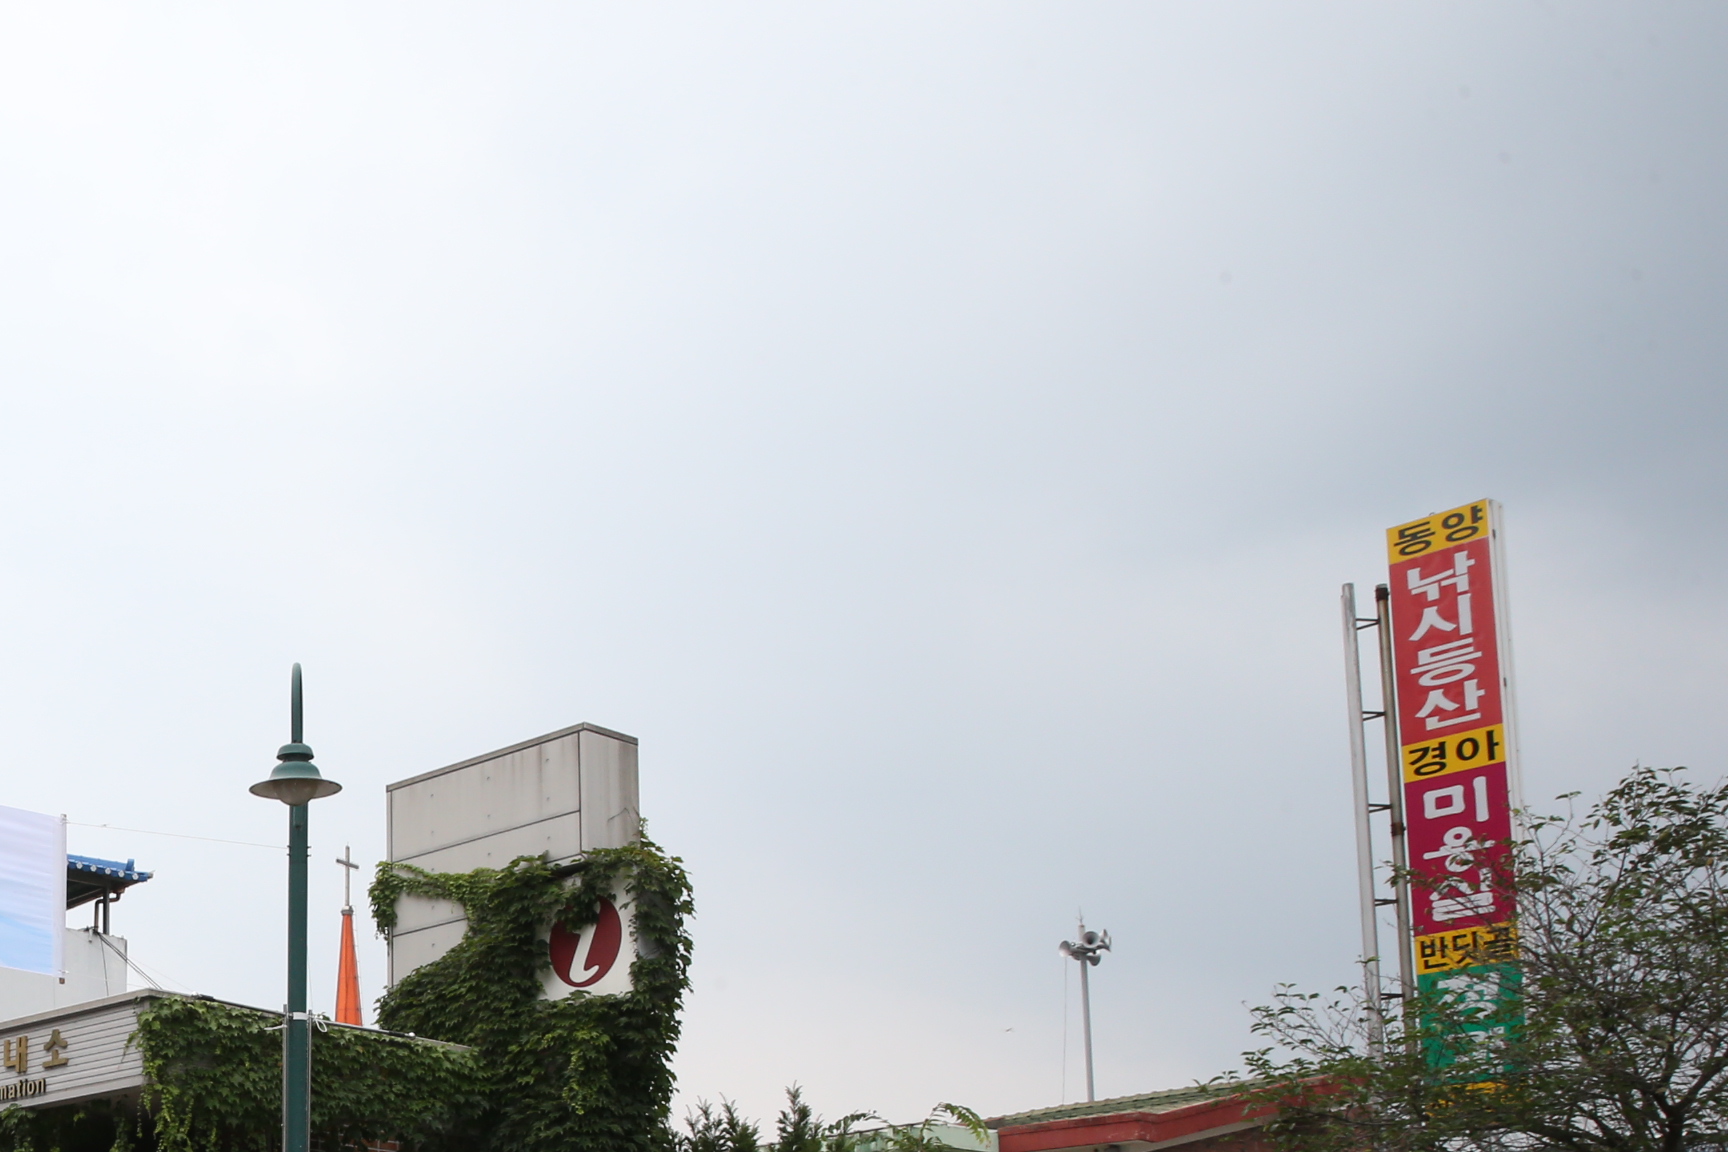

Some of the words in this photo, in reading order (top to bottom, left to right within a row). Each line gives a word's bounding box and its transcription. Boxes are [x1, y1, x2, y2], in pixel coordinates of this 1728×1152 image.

[1393, 505, 1484, 556] 동양
[1408, 729, 1500, 776] 경아
[1422, 775, 1497, 922] 미용실
